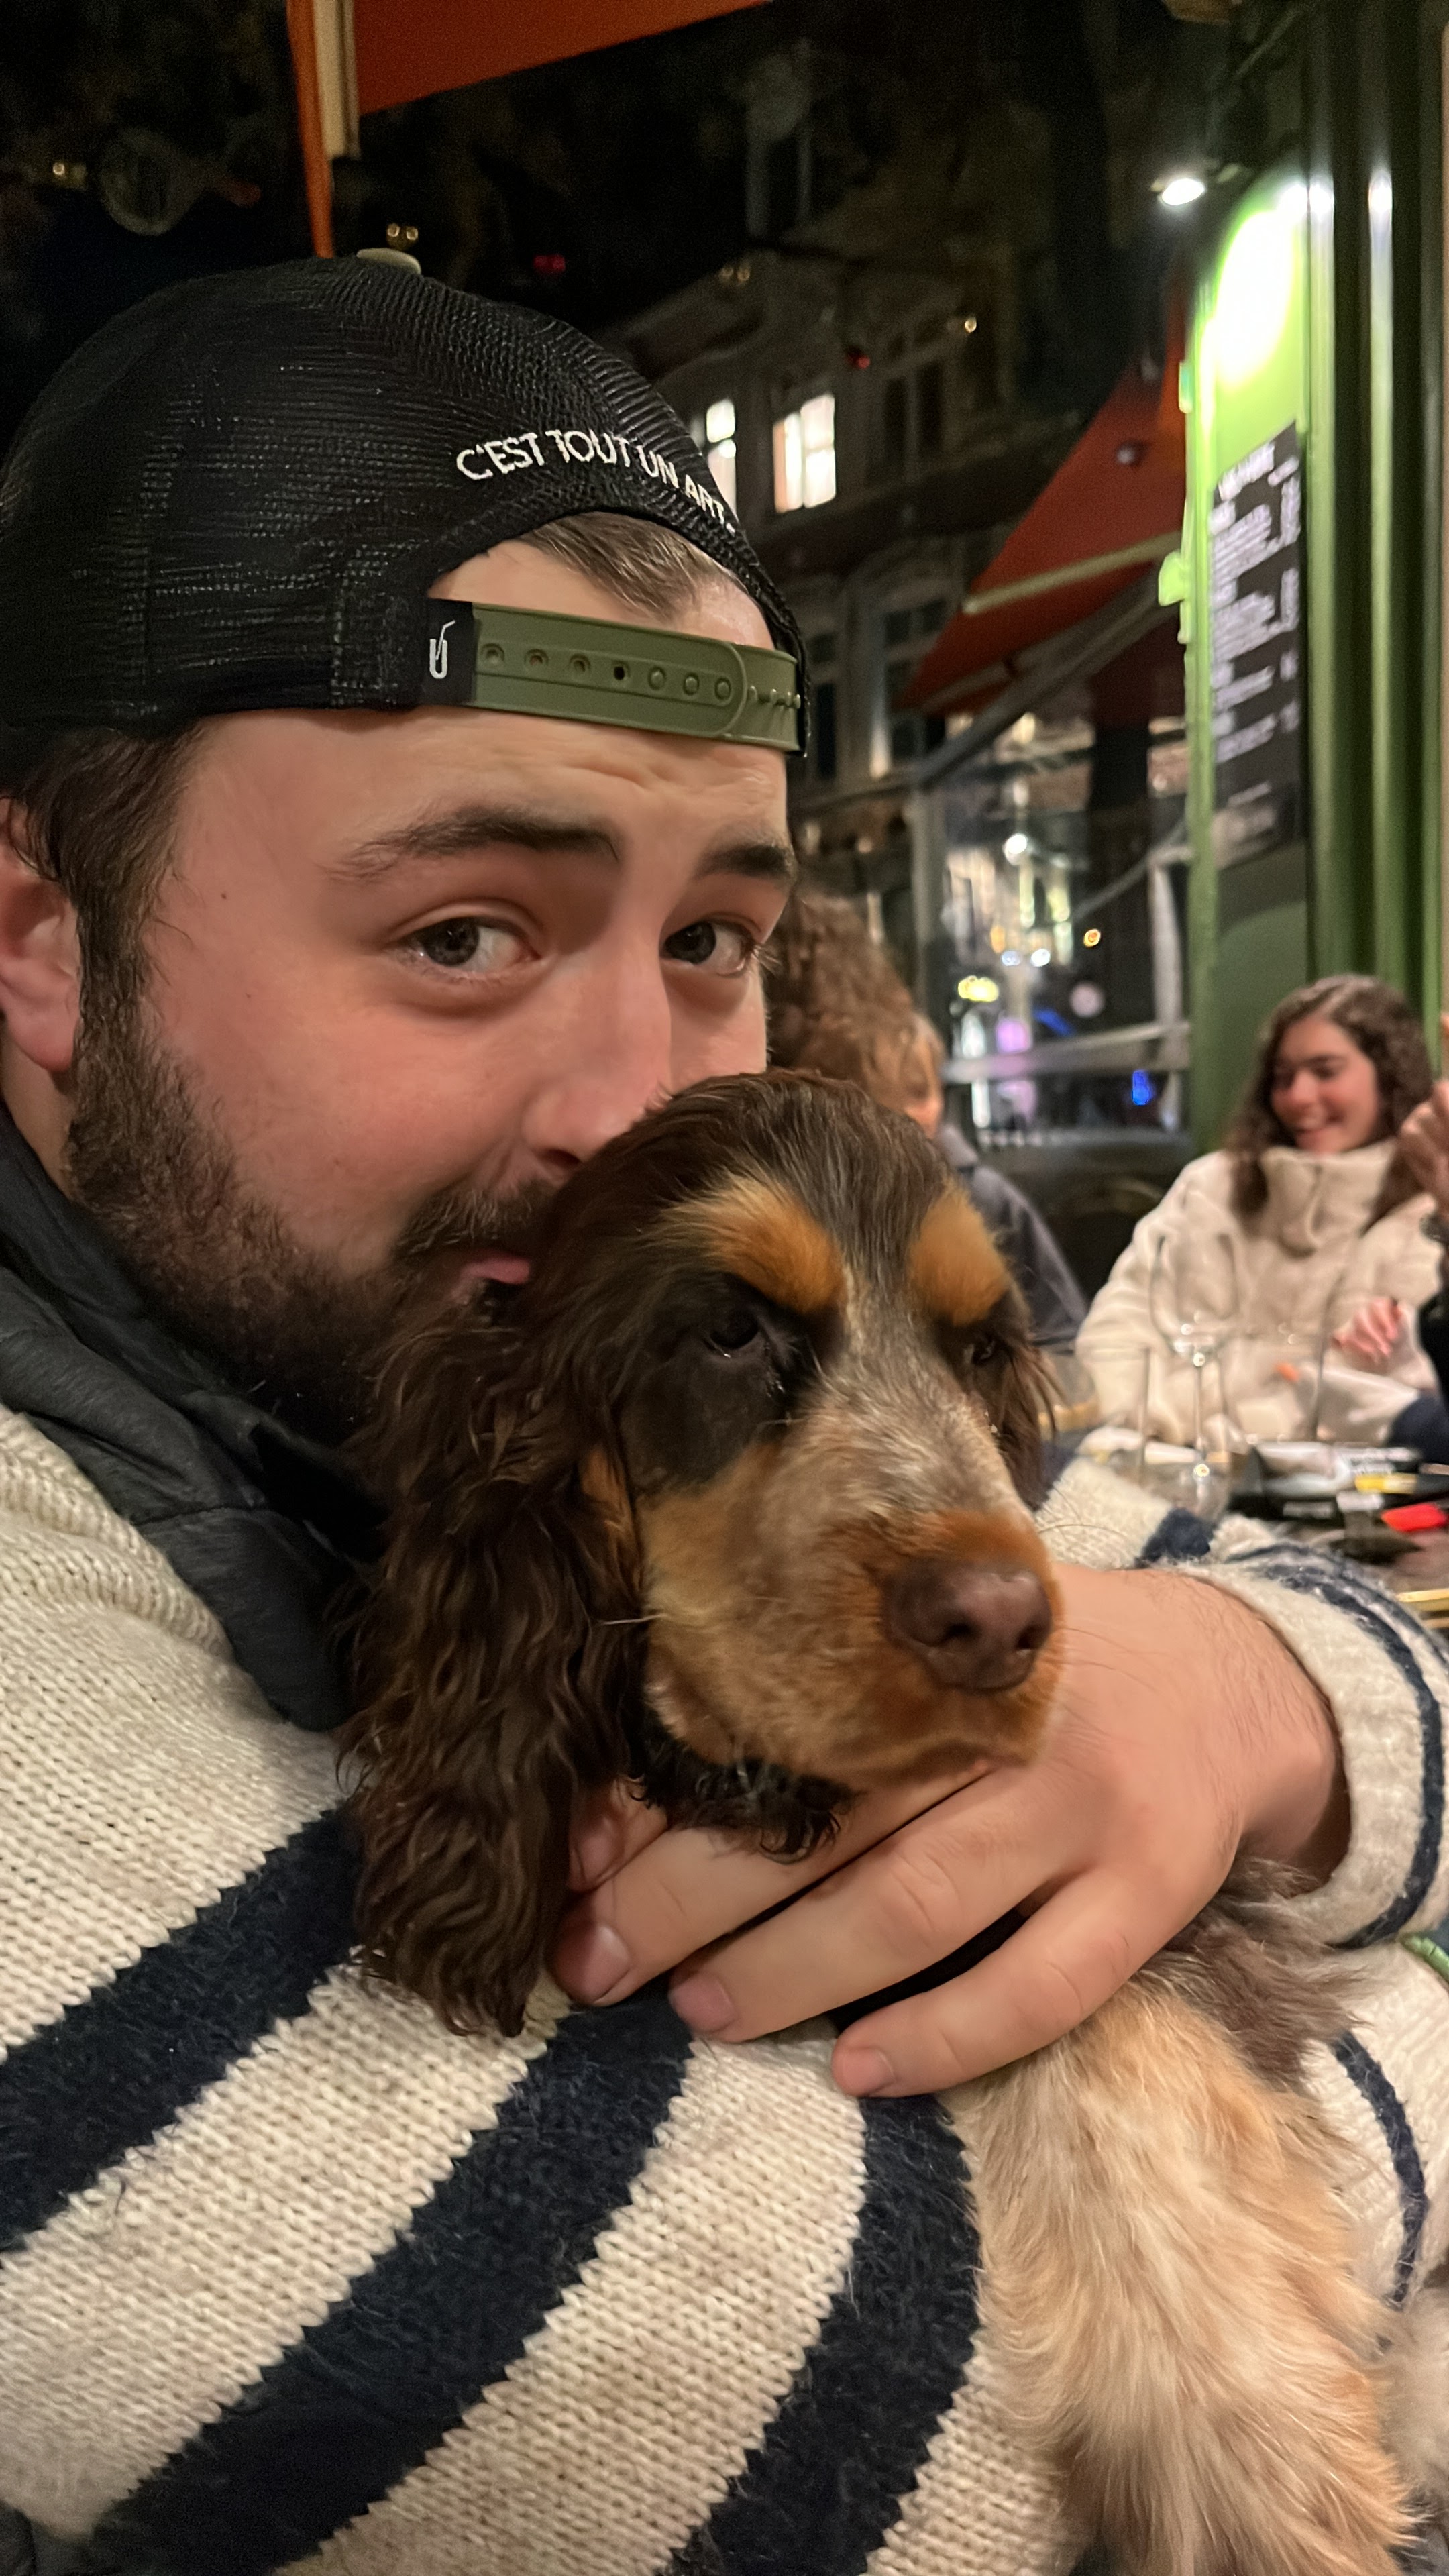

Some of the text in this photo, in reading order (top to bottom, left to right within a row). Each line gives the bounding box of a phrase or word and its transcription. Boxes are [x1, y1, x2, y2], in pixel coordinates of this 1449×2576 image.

[456, 432, 545, 480] C'EST
[545, 428, 631, 468] TOUT
[636, 445, 680, 489] UN
